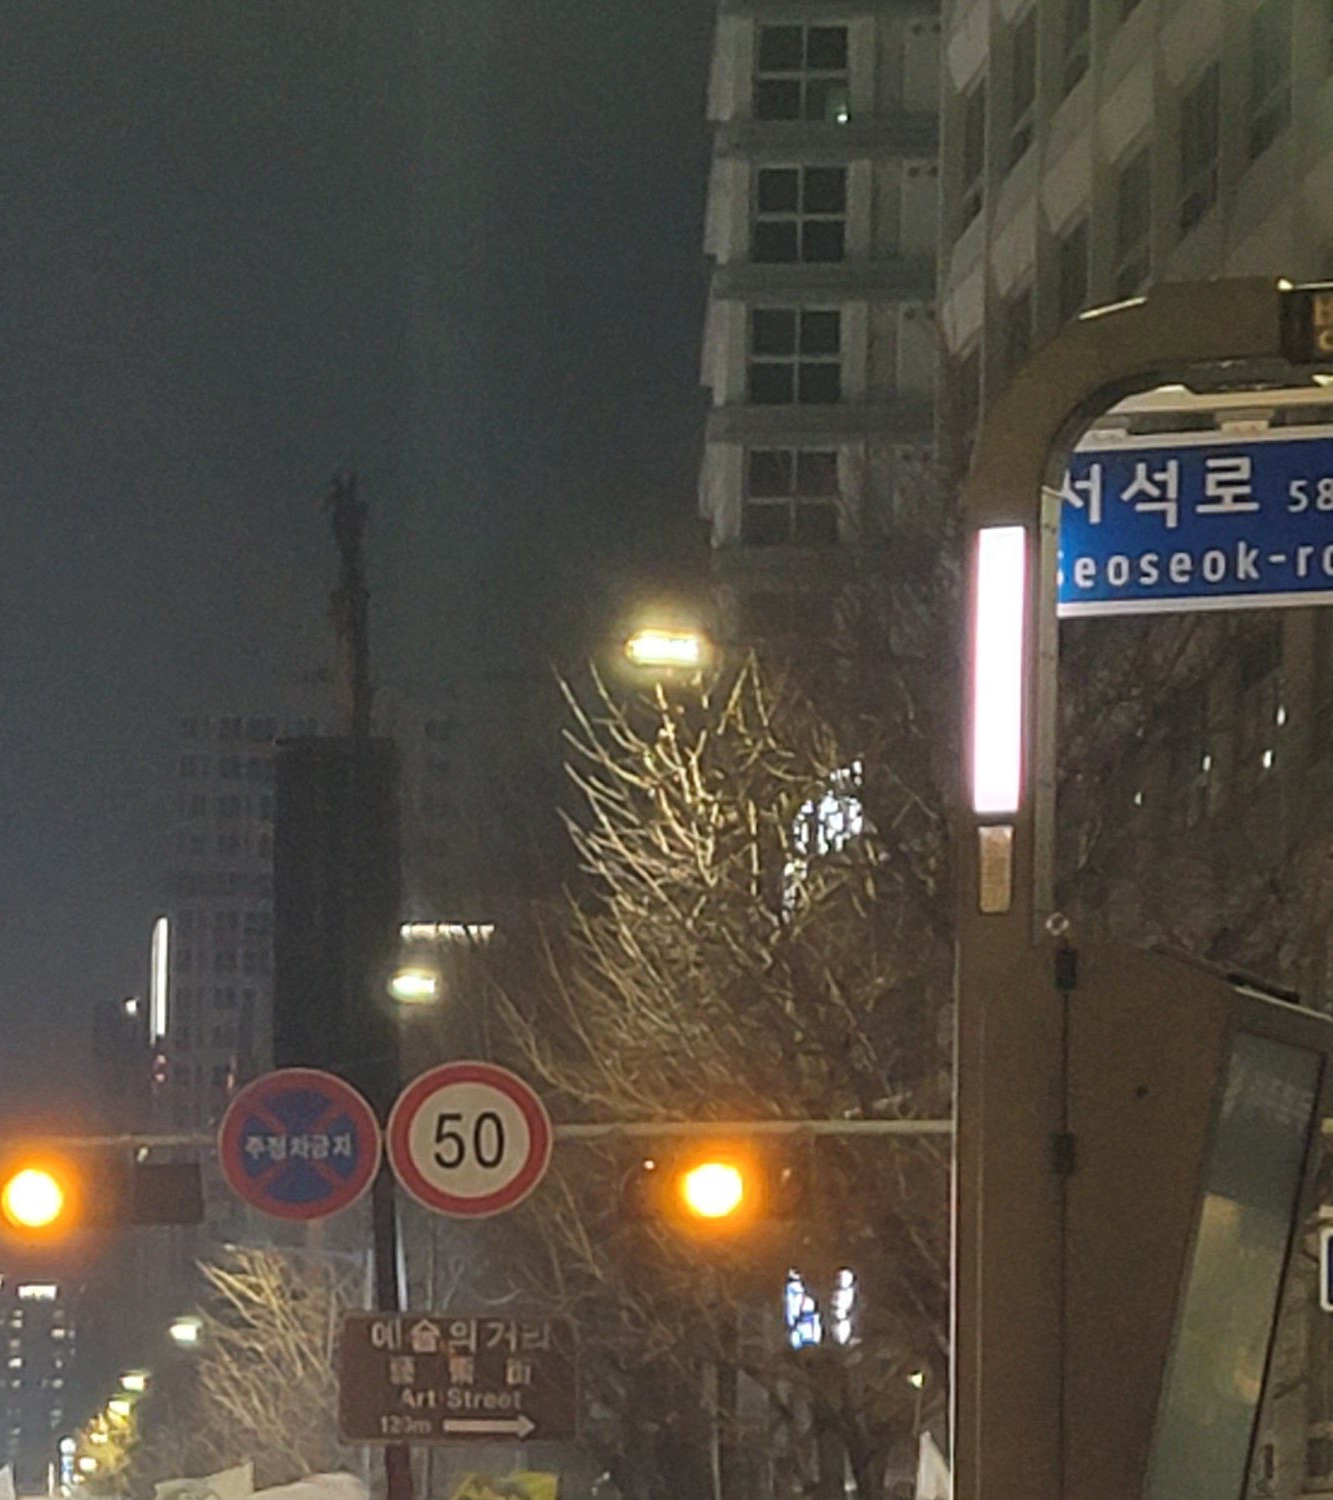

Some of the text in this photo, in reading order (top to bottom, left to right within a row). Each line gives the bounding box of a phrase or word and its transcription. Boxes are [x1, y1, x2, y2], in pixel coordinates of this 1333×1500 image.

[1060, 455, 1260, 528] 서석로
[1056, 541, 1333, 589] eoseok-r
[434, 1111, 505, 1170] 50
[400, 1386, 523, 1410] Art Street
